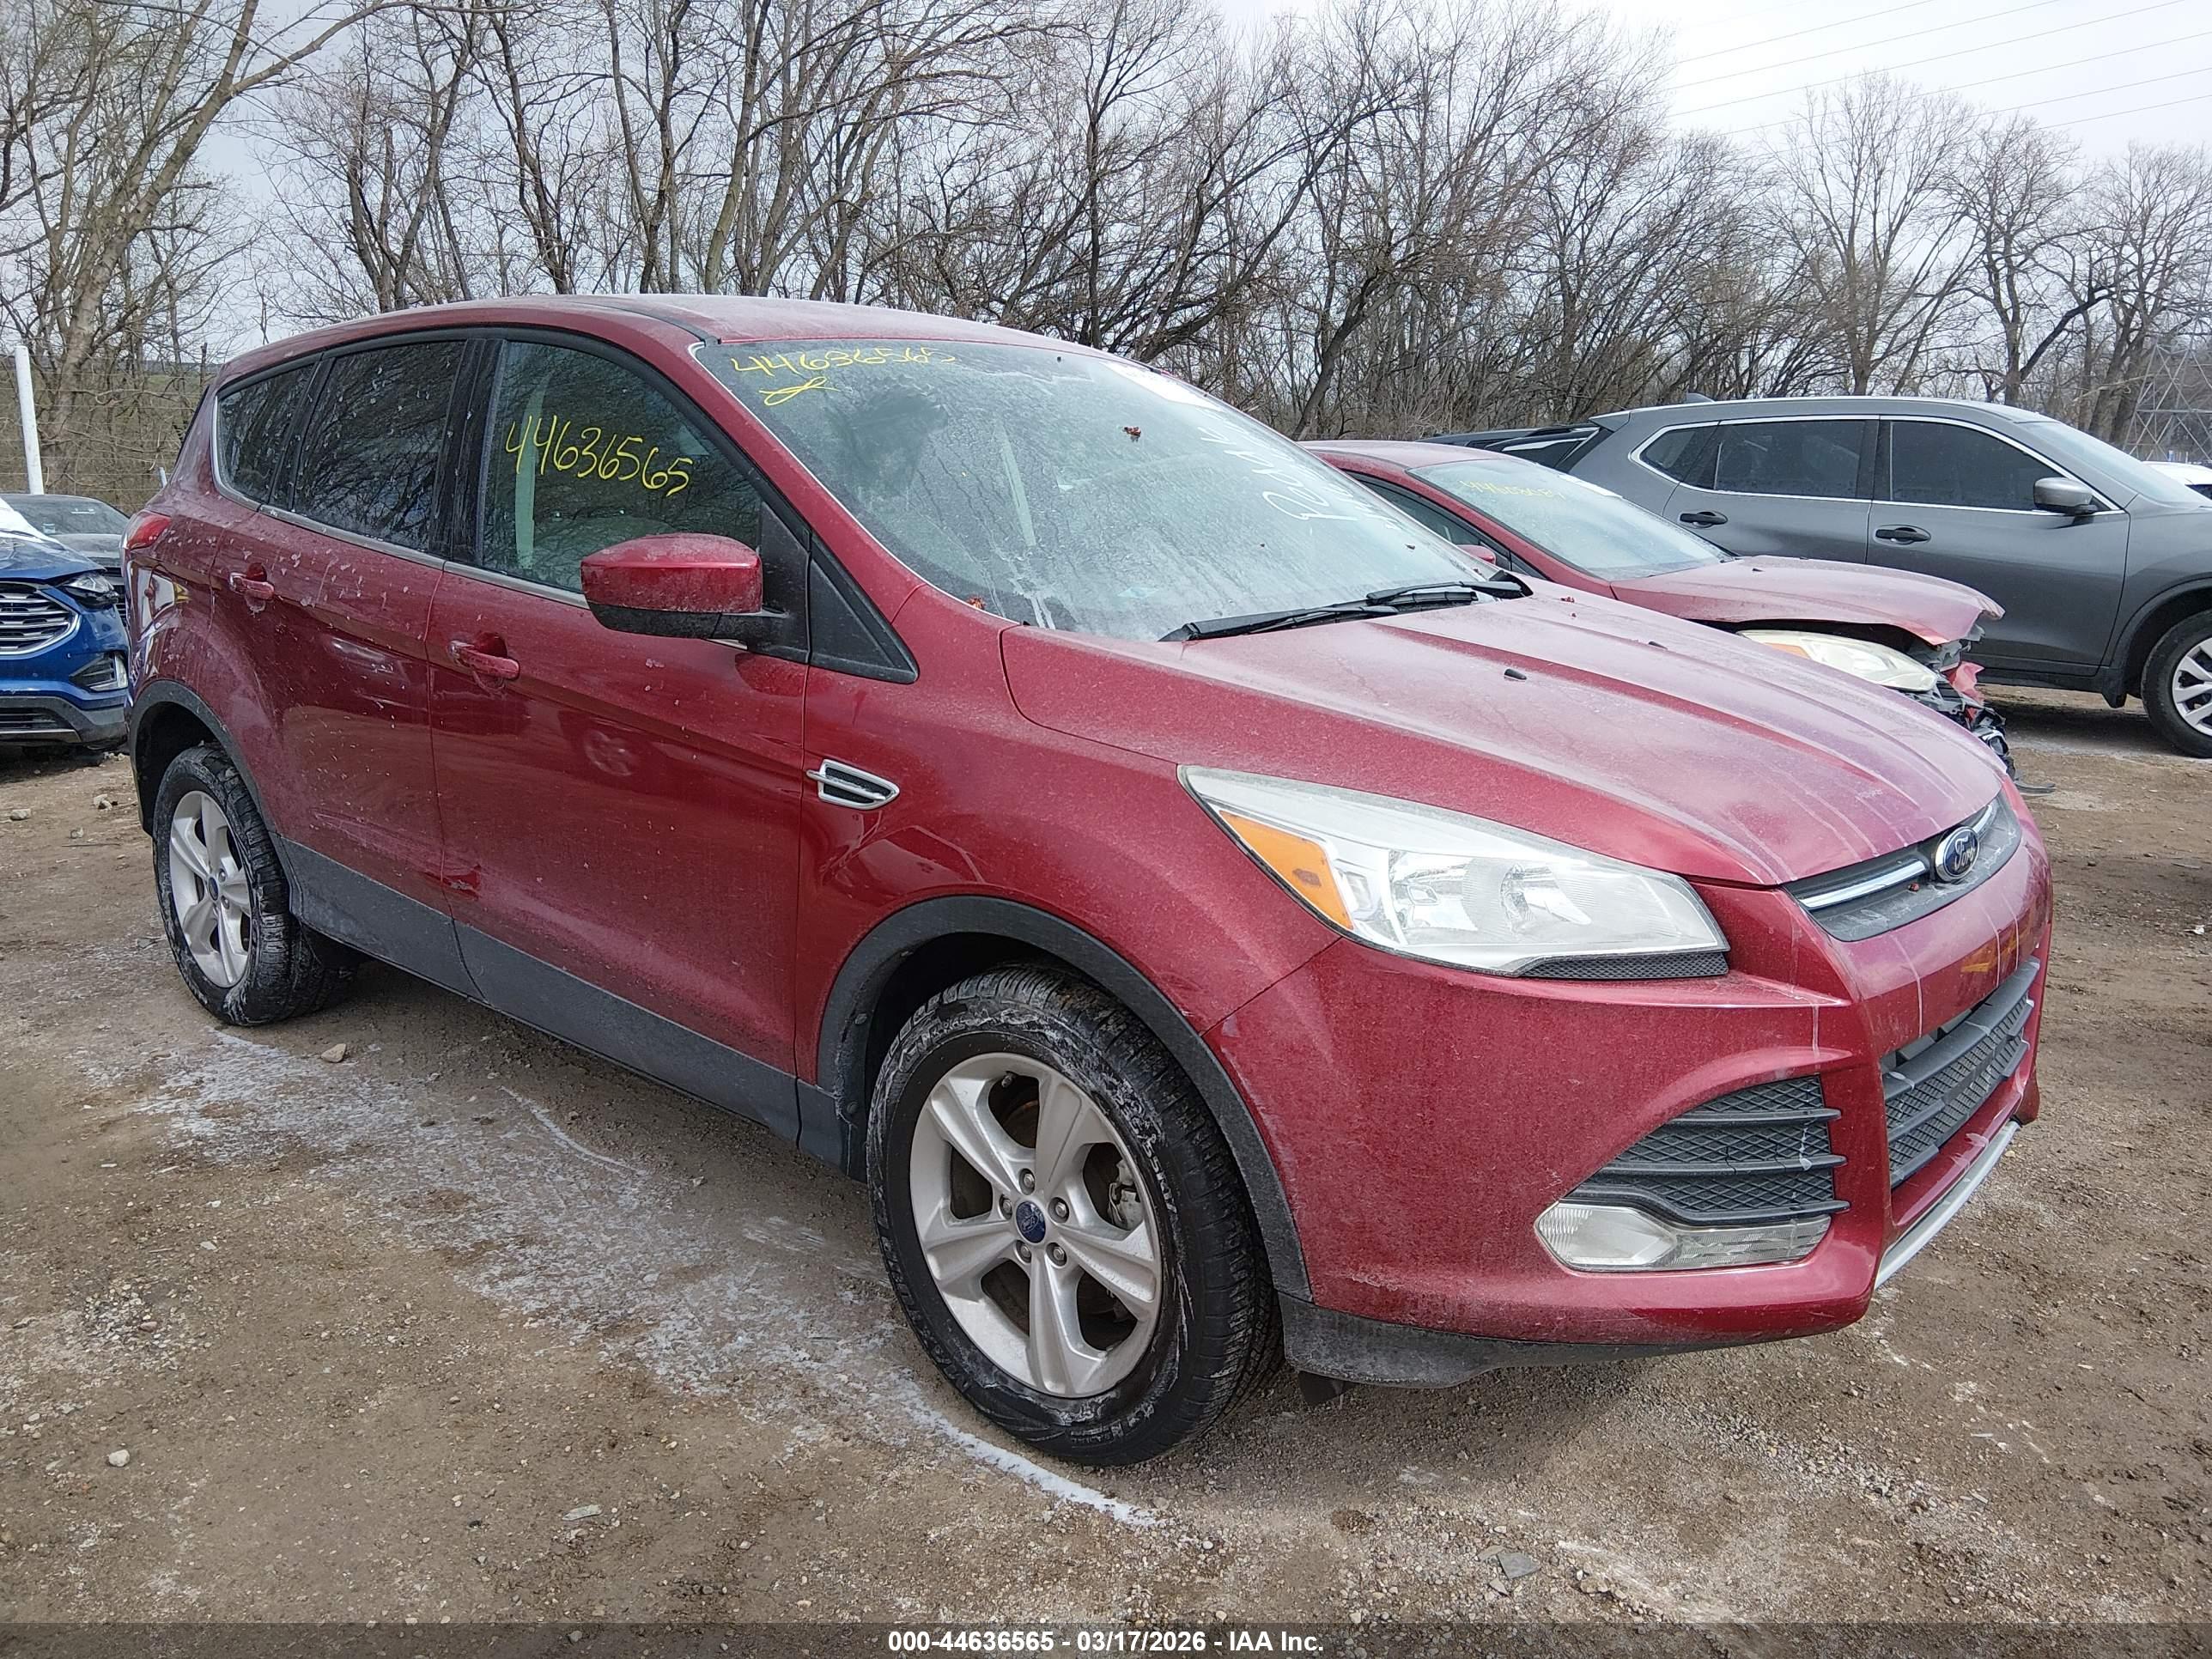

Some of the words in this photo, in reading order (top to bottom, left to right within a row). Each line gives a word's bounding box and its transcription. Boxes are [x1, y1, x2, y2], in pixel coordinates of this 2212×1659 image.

[731, 346, 956, 377] 44636565
[505, 415, 693, 496] 44636565
[1954, 836, 1976, 871] Ford
